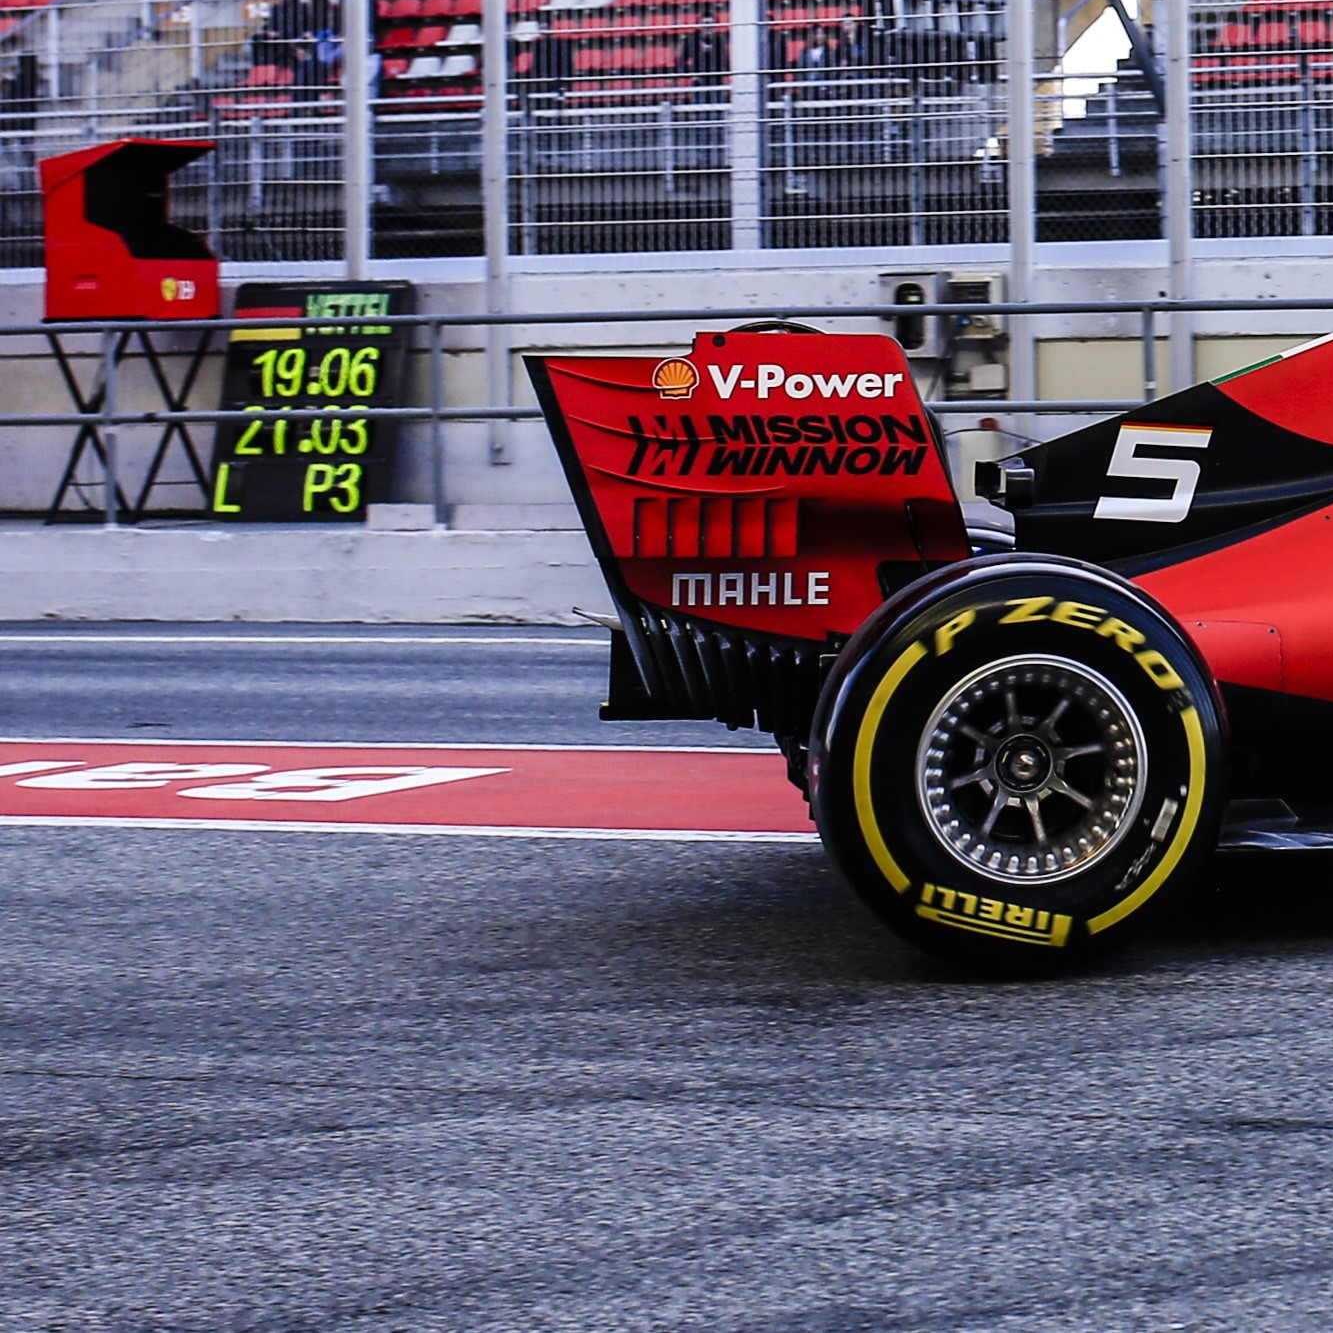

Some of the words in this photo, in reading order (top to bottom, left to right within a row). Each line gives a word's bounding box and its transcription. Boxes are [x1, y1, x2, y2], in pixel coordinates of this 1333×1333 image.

[253, 346, 381, 398] 19.06
[706, 363, 904, 400] V-Power
[705, 414, 929, 445] MISSION
[705, 445, 929, 477] WINNOW
[1092, 421, 1213, 524] 5
[213, 462, 242, 513] L
[303, 462, 363, 513] P3
[671, 571, 830, 606] MAHLE
[934, 608, 977, 657] P
[999, 595, 1186, 692] ZERO
[914, 882, 1075, 948] PIRELLI
